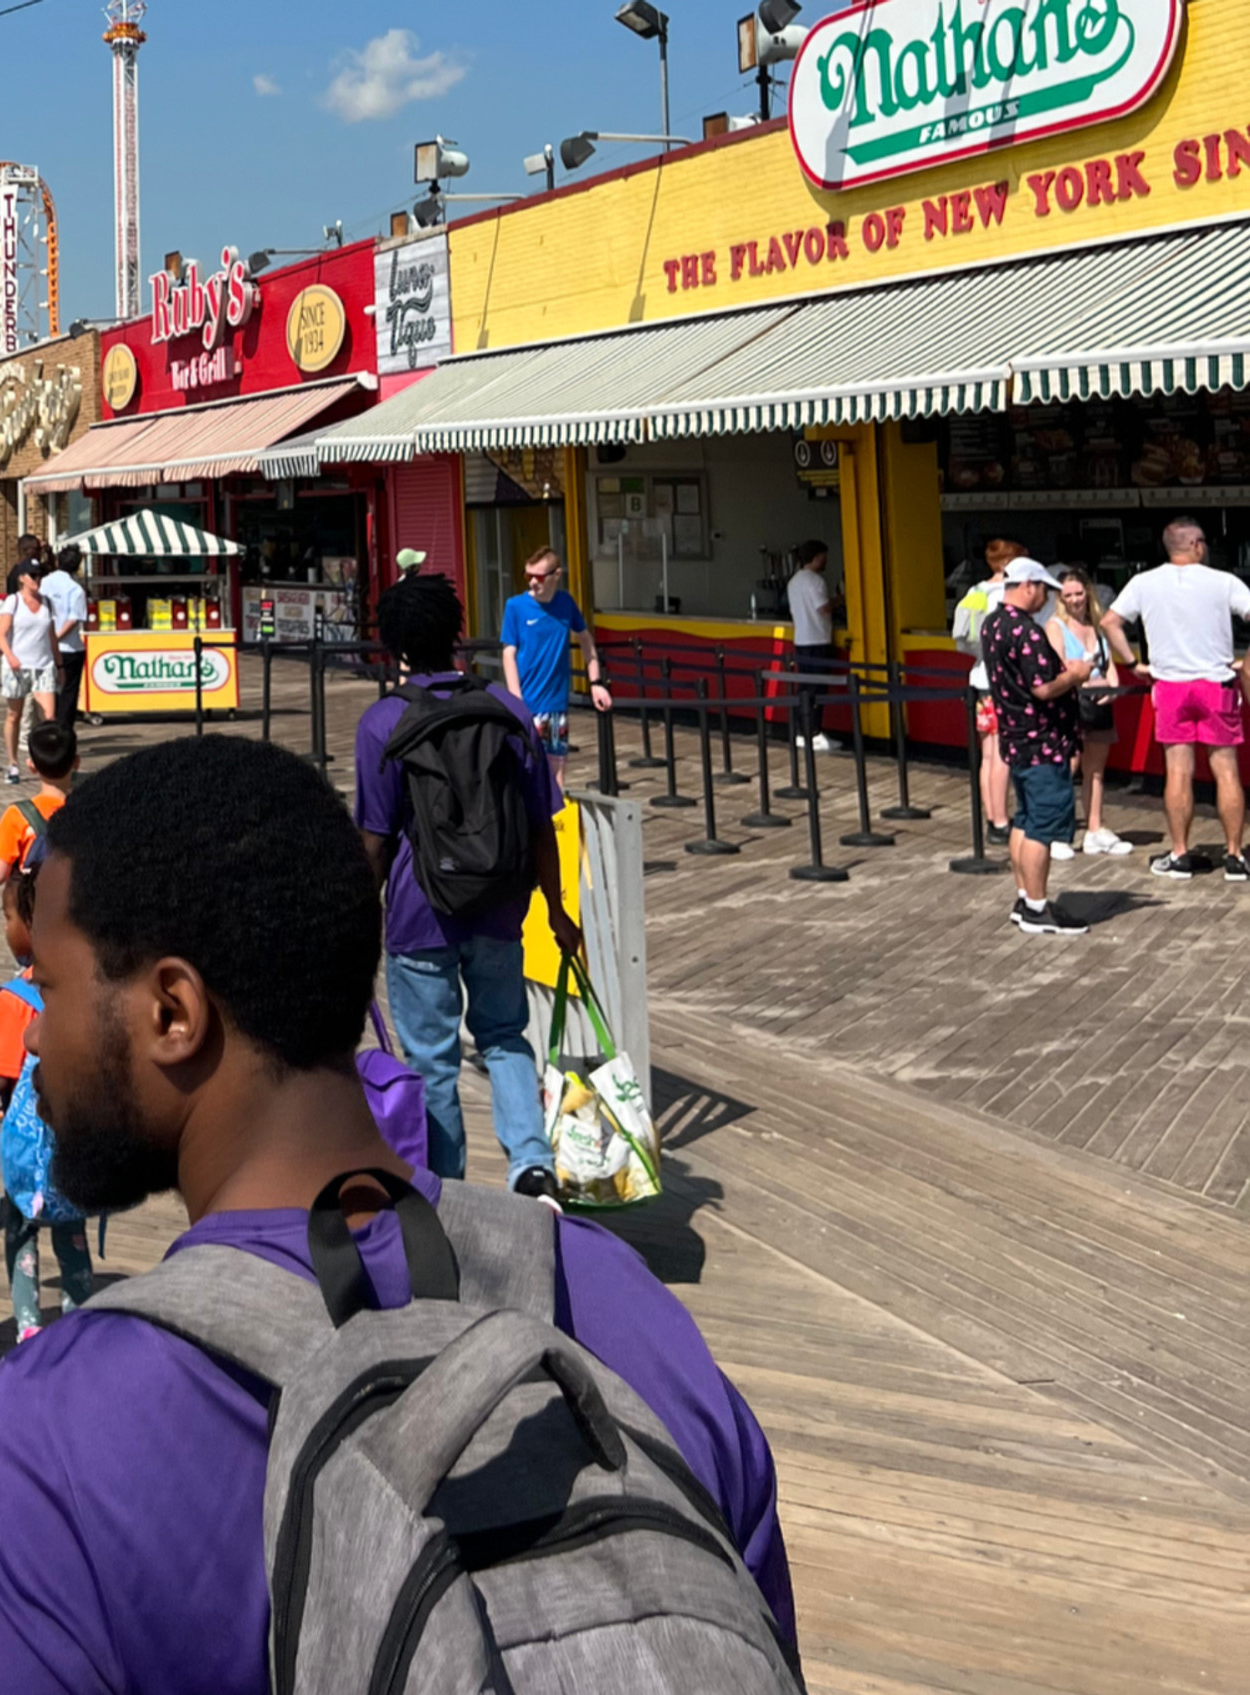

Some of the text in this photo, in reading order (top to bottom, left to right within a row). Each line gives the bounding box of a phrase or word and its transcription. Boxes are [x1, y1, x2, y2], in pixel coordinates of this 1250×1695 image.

[816, 0, 1126, 129] Nathans
[918, 101, 1021, 144] FAMOUS
[664, 250, 717, 293] THE
[729, 220, 849, 281] FLAVOR
[862, 206, 906, 252] OF
[922, 181, 1010, 240] NEW
[1027, 151, 1151, 217] YORK
[148, 246, 246, 350] Ruby's
[301, 302, 325, 329] SINCE
[304, 329, 324, 355] 1934
[199, 347, 227, 386] Grill
[631, 497, 641, 512] B
